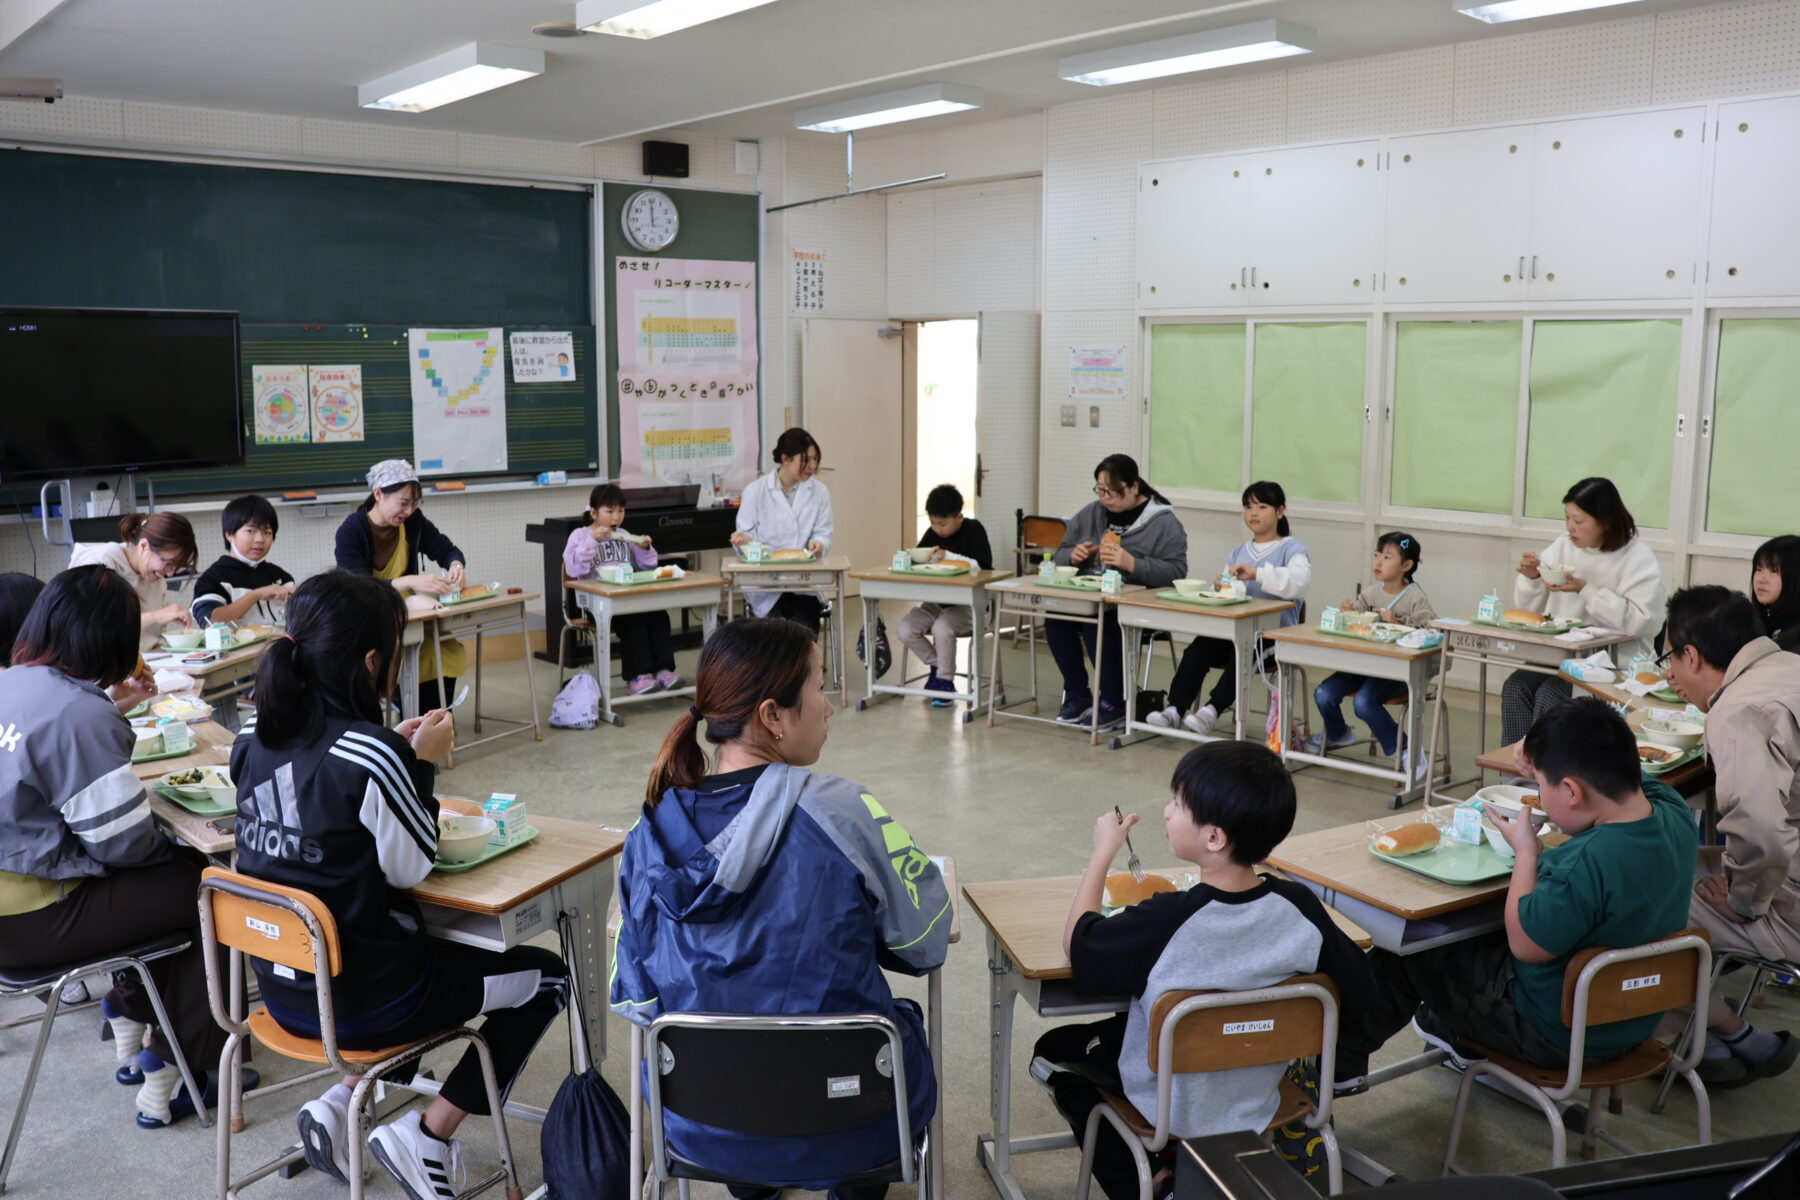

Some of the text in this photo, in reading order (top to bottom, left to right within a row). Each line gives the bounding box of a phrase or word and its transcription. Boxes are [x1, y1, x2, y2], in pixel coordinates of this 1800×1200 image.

[235, 815, 324, 863] adidas
[1226, 1024, 1245, 1033] にいやま
